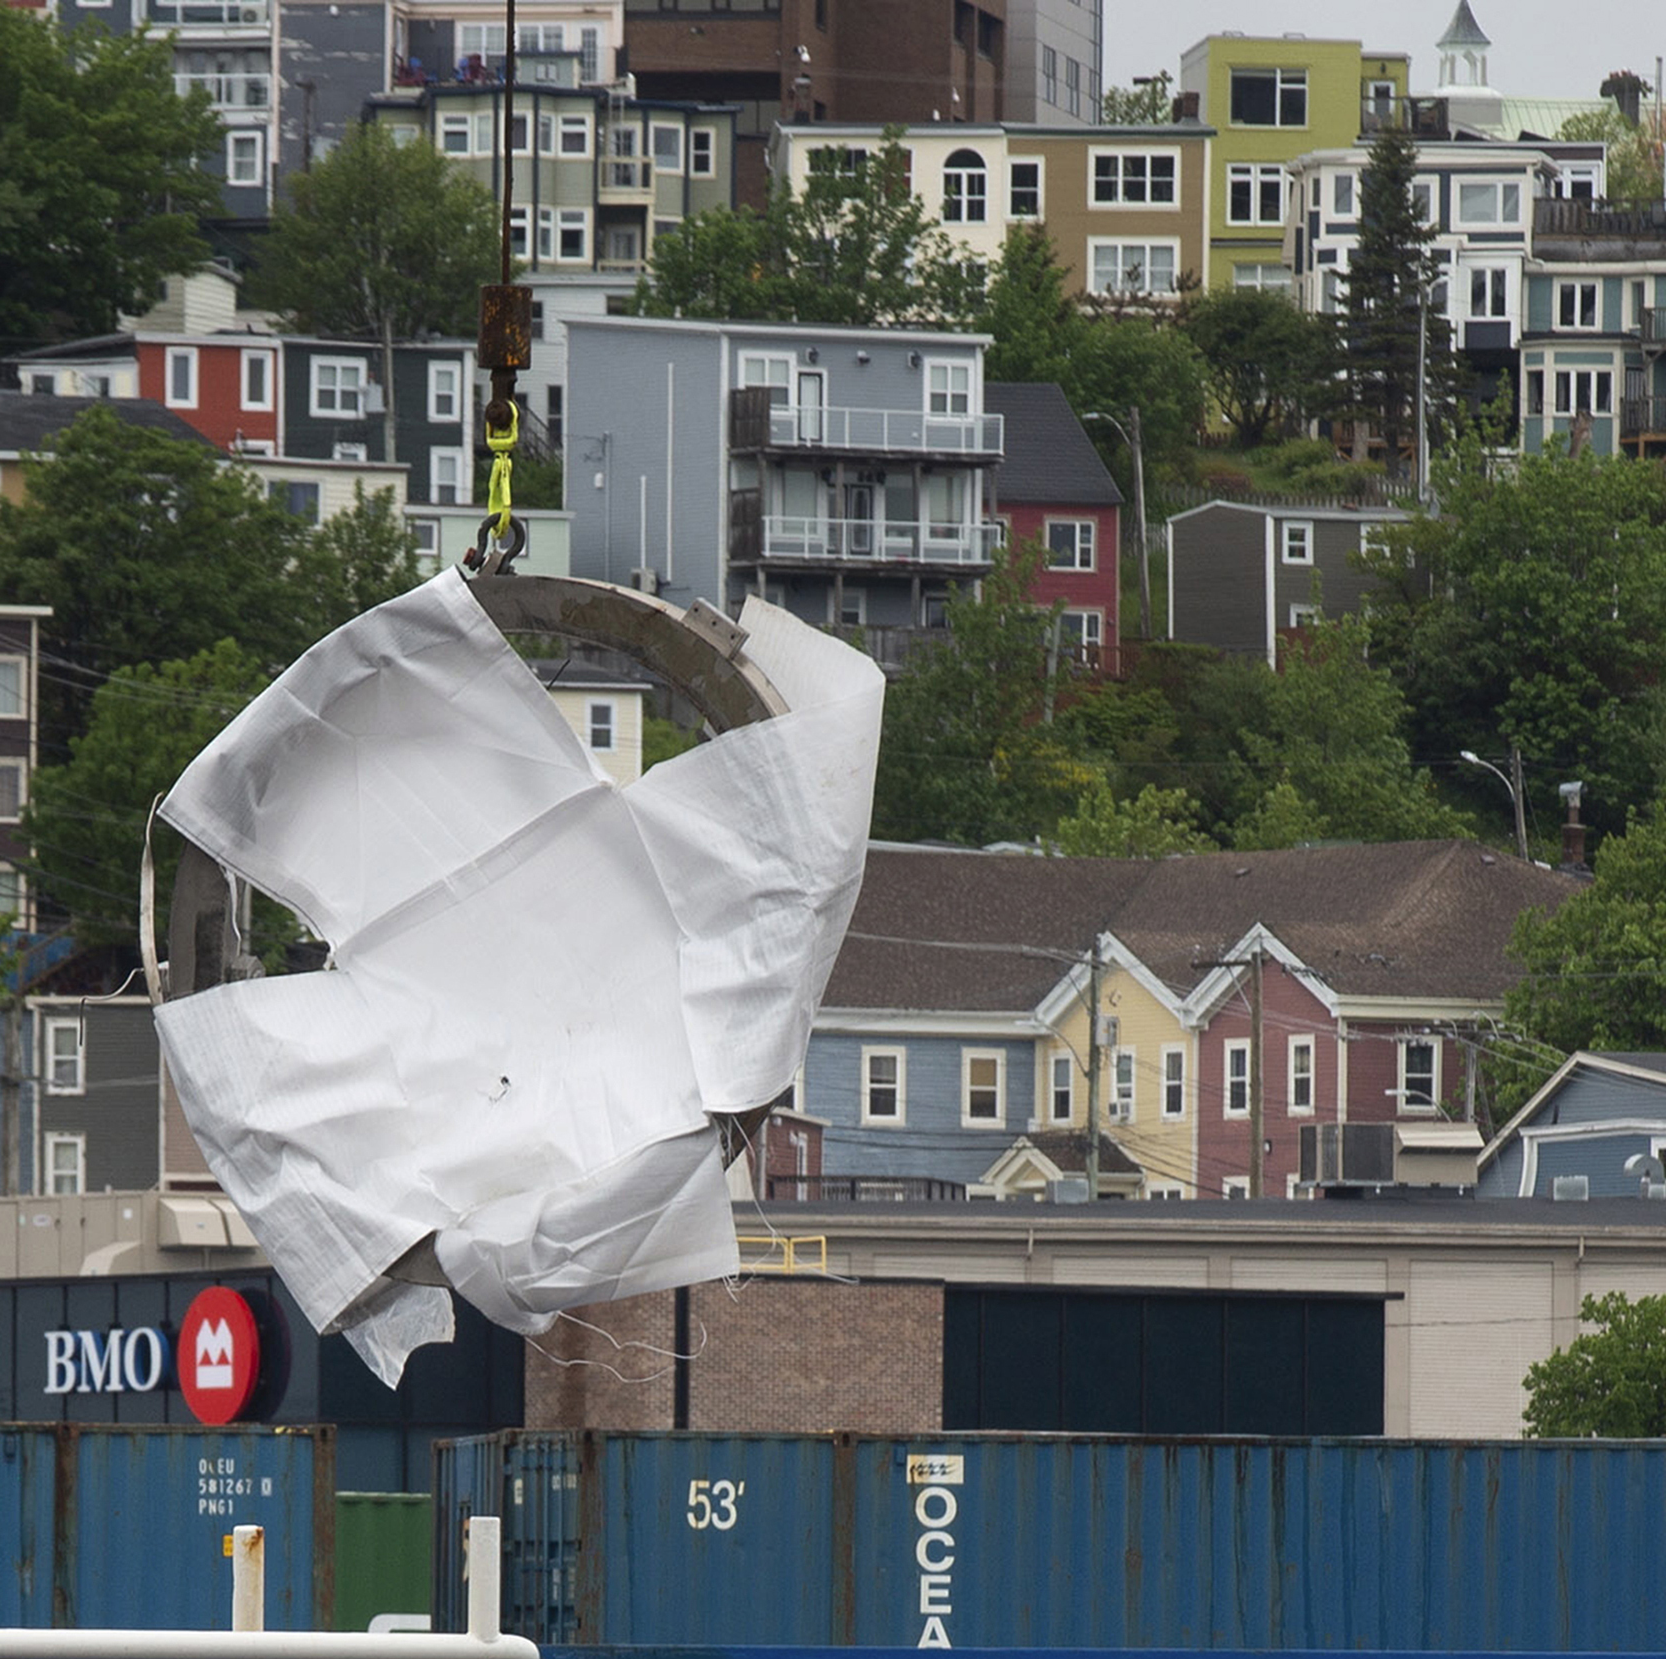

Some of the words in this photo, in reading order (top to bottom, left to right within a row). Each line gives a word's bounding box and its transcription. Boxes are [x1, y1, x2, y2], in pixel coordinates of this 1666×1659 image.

[44, 1327, 162, 1394] BMO
[199, 1478, 253, 1495] 581267
[687, 1480, 745, 1530] 53'
[915, 1486, 957, 1649] OCEA
